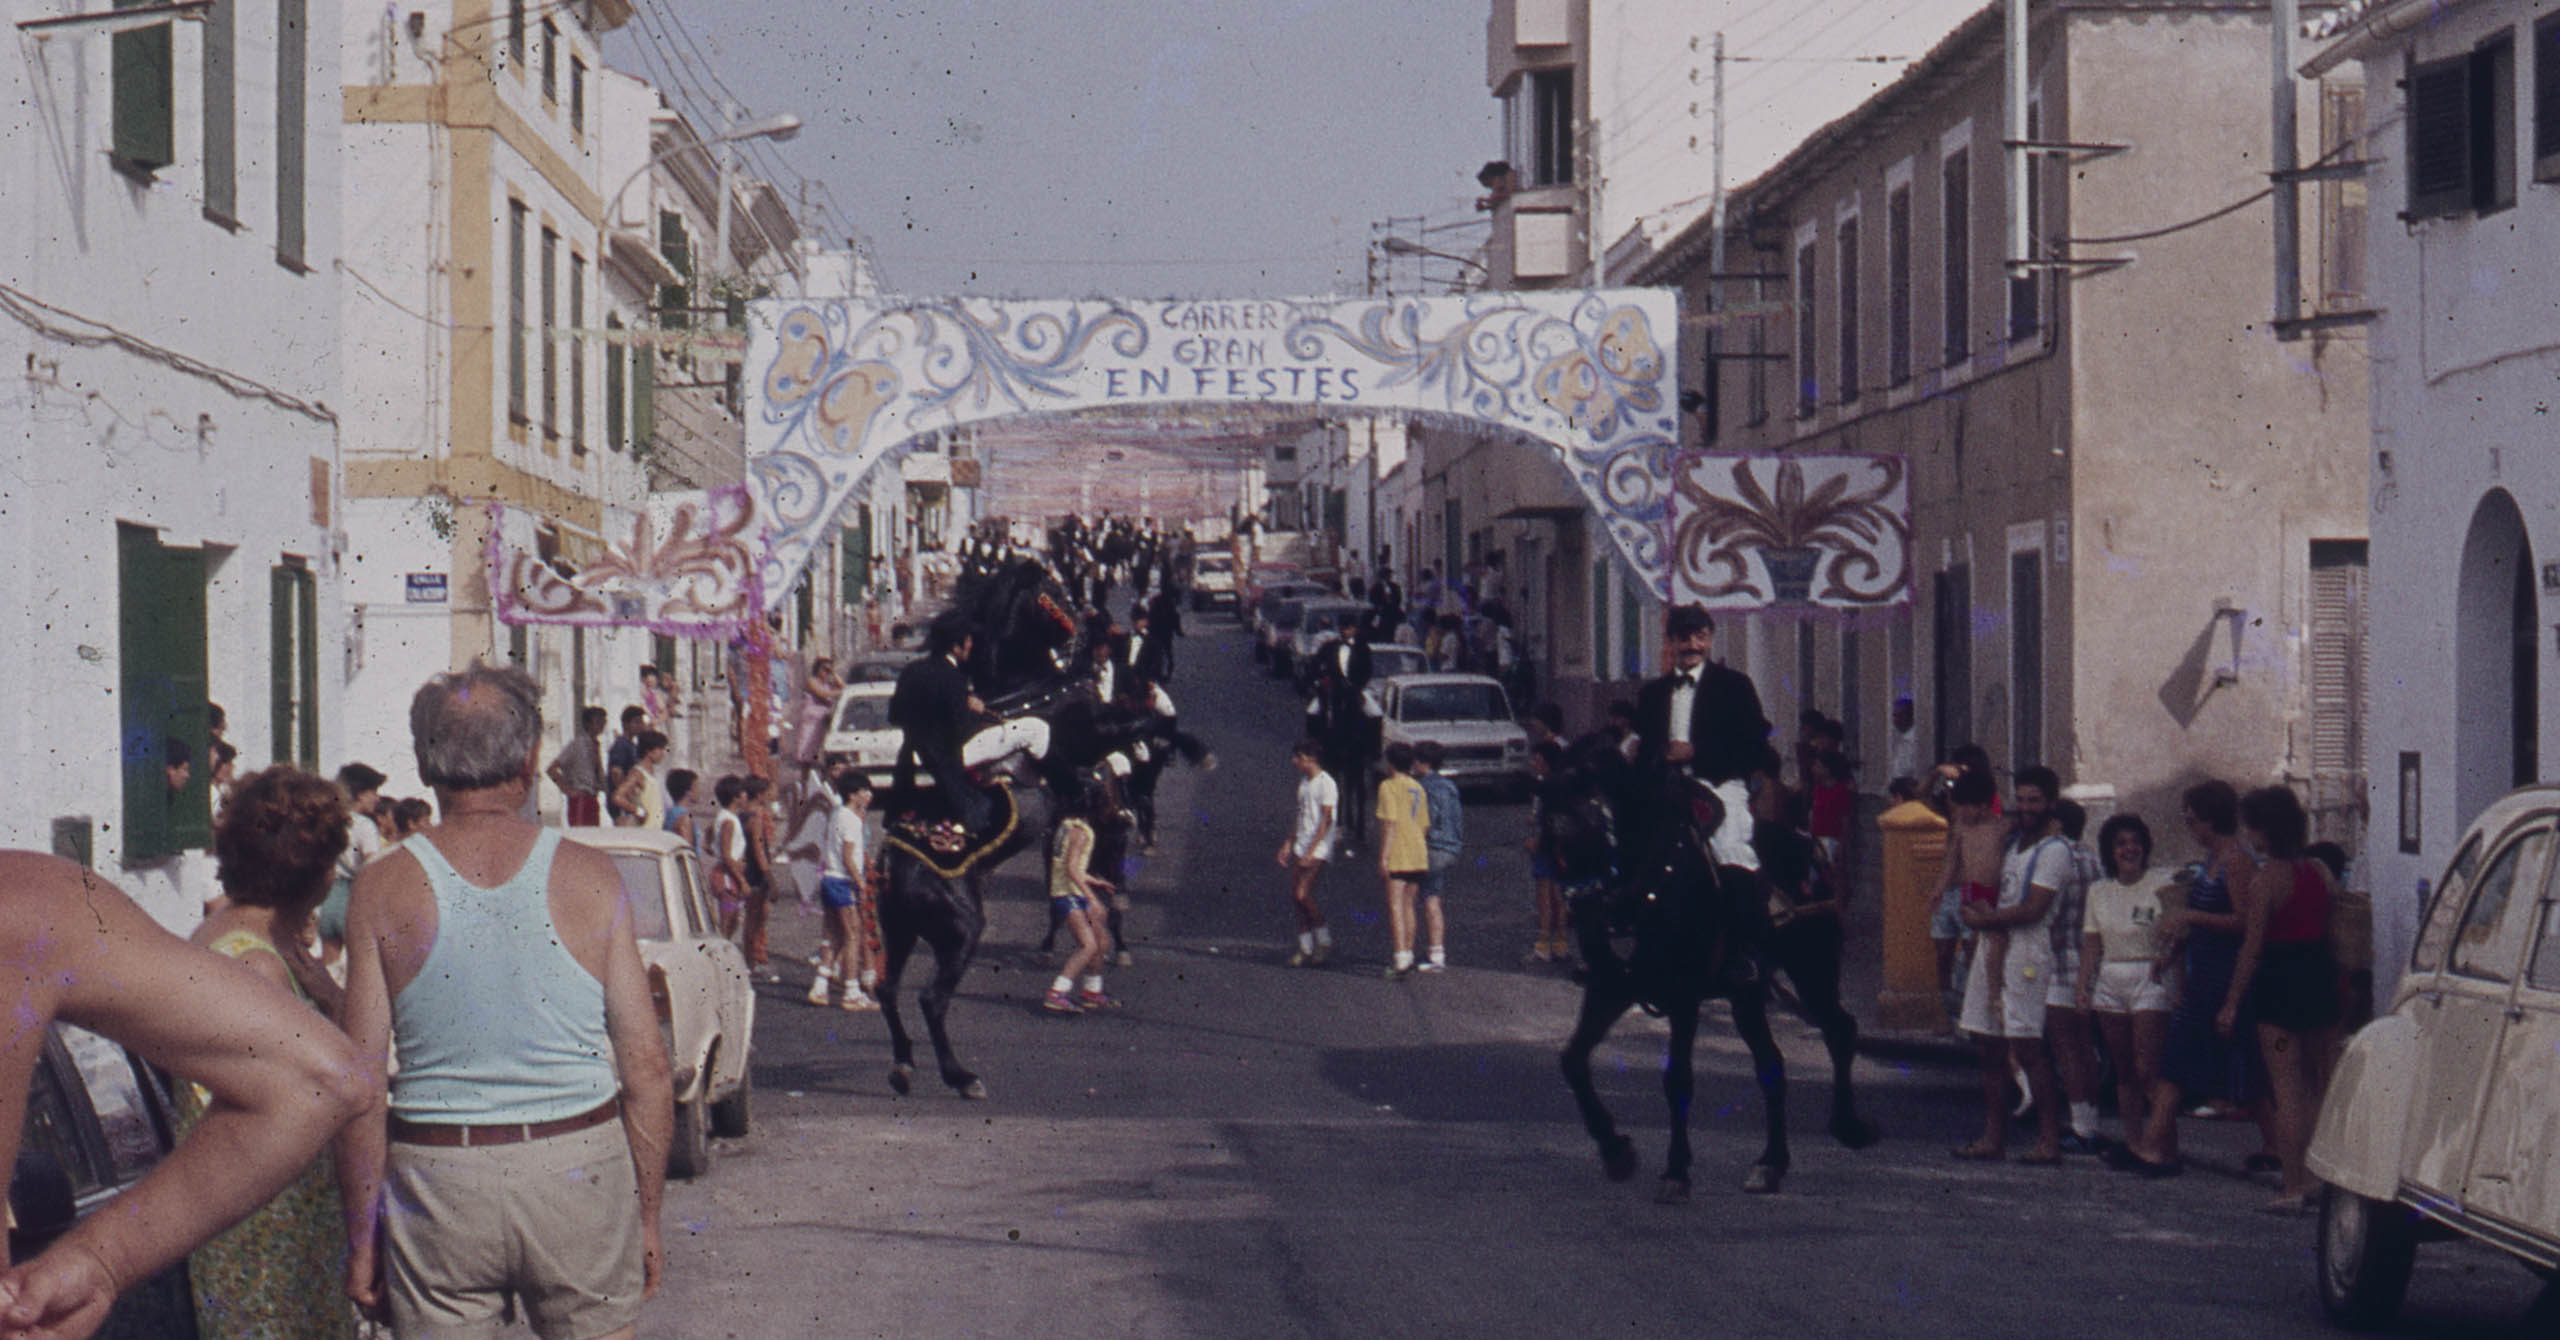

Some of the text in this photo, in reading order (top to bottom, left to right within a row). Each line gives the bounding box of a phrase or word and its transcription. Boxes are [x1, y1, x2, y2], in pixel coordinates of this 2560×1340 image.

[1161, 302, 1277, 331] CARRER
[1172, 337, 1266, 366] GRAN
[1105, 366, 1359, 401] EN FESTES
